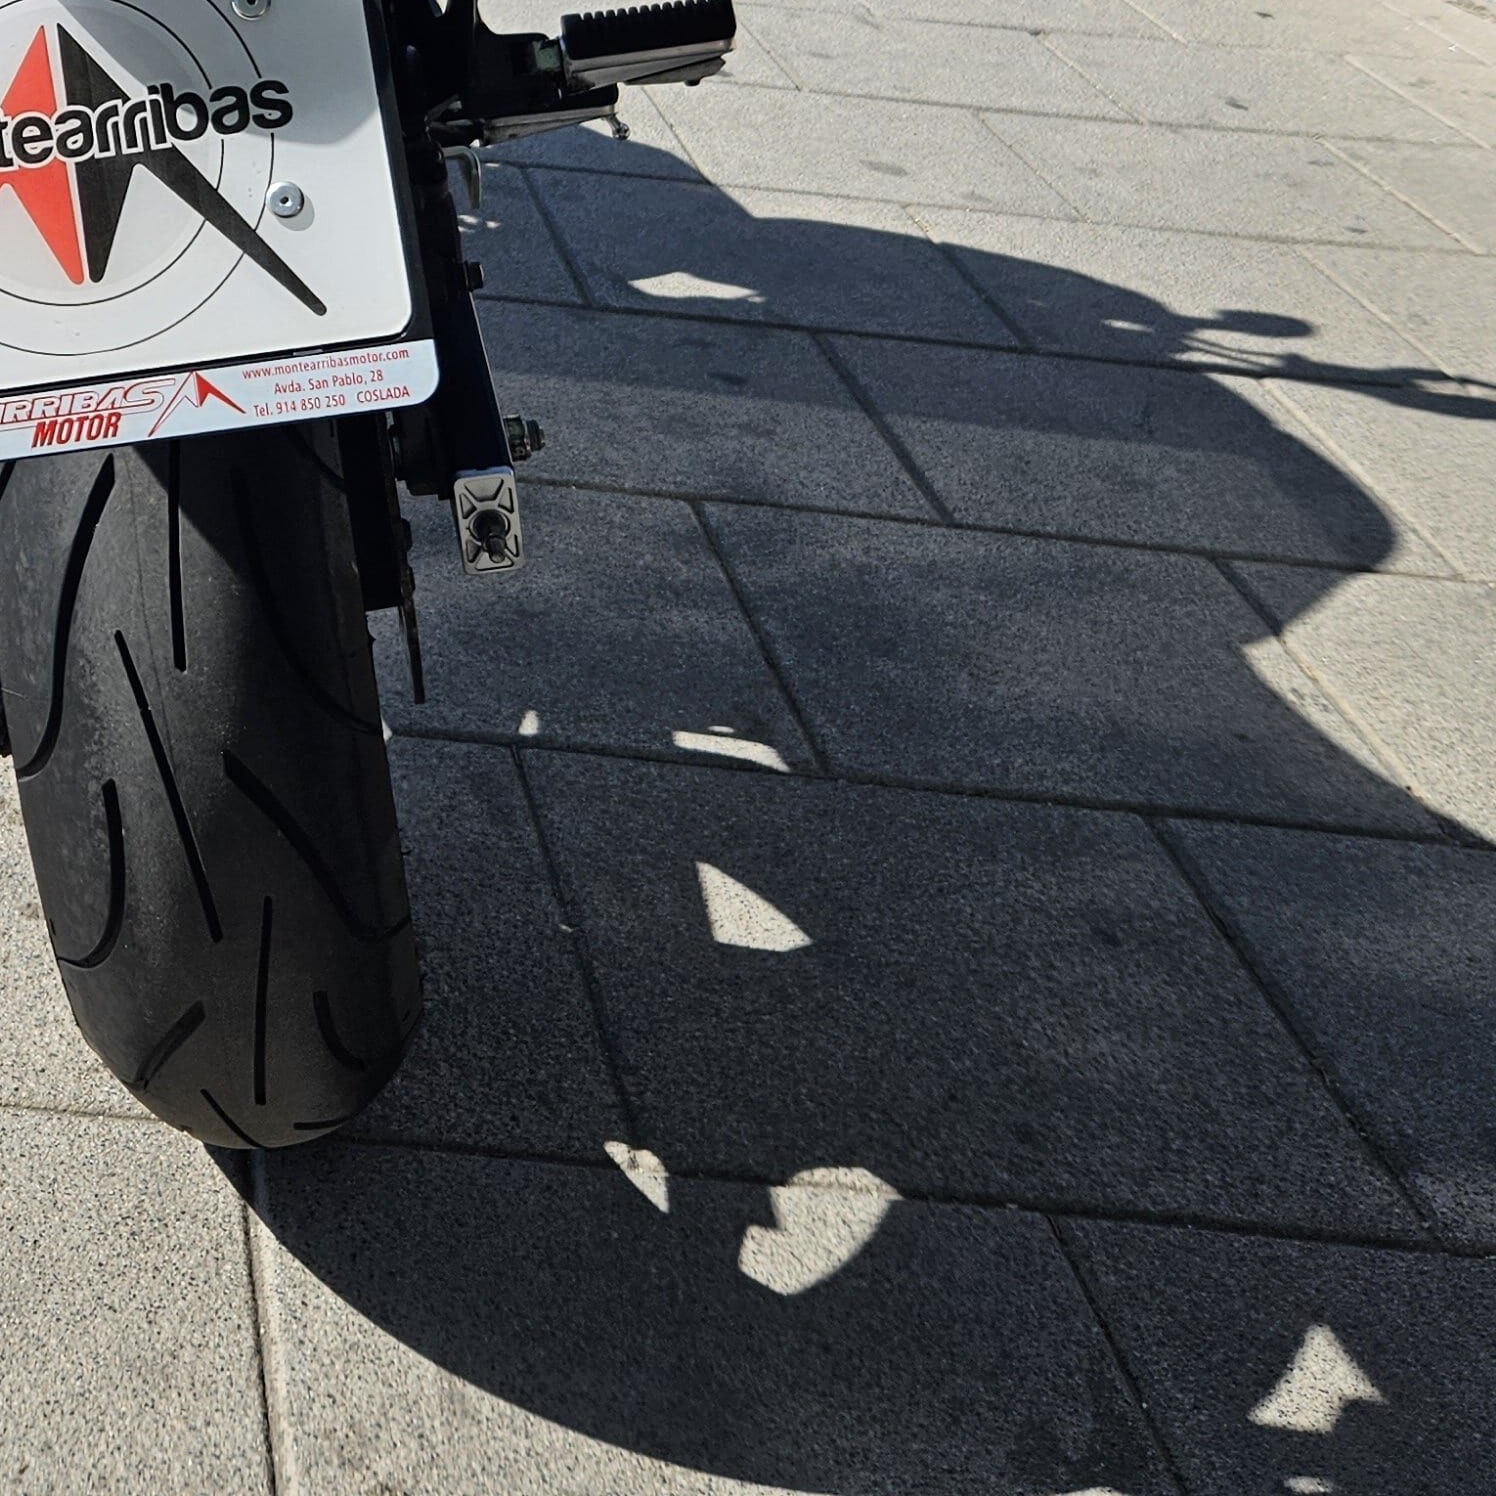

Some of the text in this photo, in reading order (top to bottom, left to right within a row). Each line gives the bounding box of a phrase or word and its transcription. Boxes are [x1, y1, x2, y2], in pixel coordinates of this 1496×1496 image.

[242, 348, 410, 379] www.montearribasmotor.com
[273, 369, 384, 395] Avda. San Pablo, 28
[254, 385, 410, 418] Tel. 914 850 250 COSLADA
[31, 412, 123, 448] MOTOR
